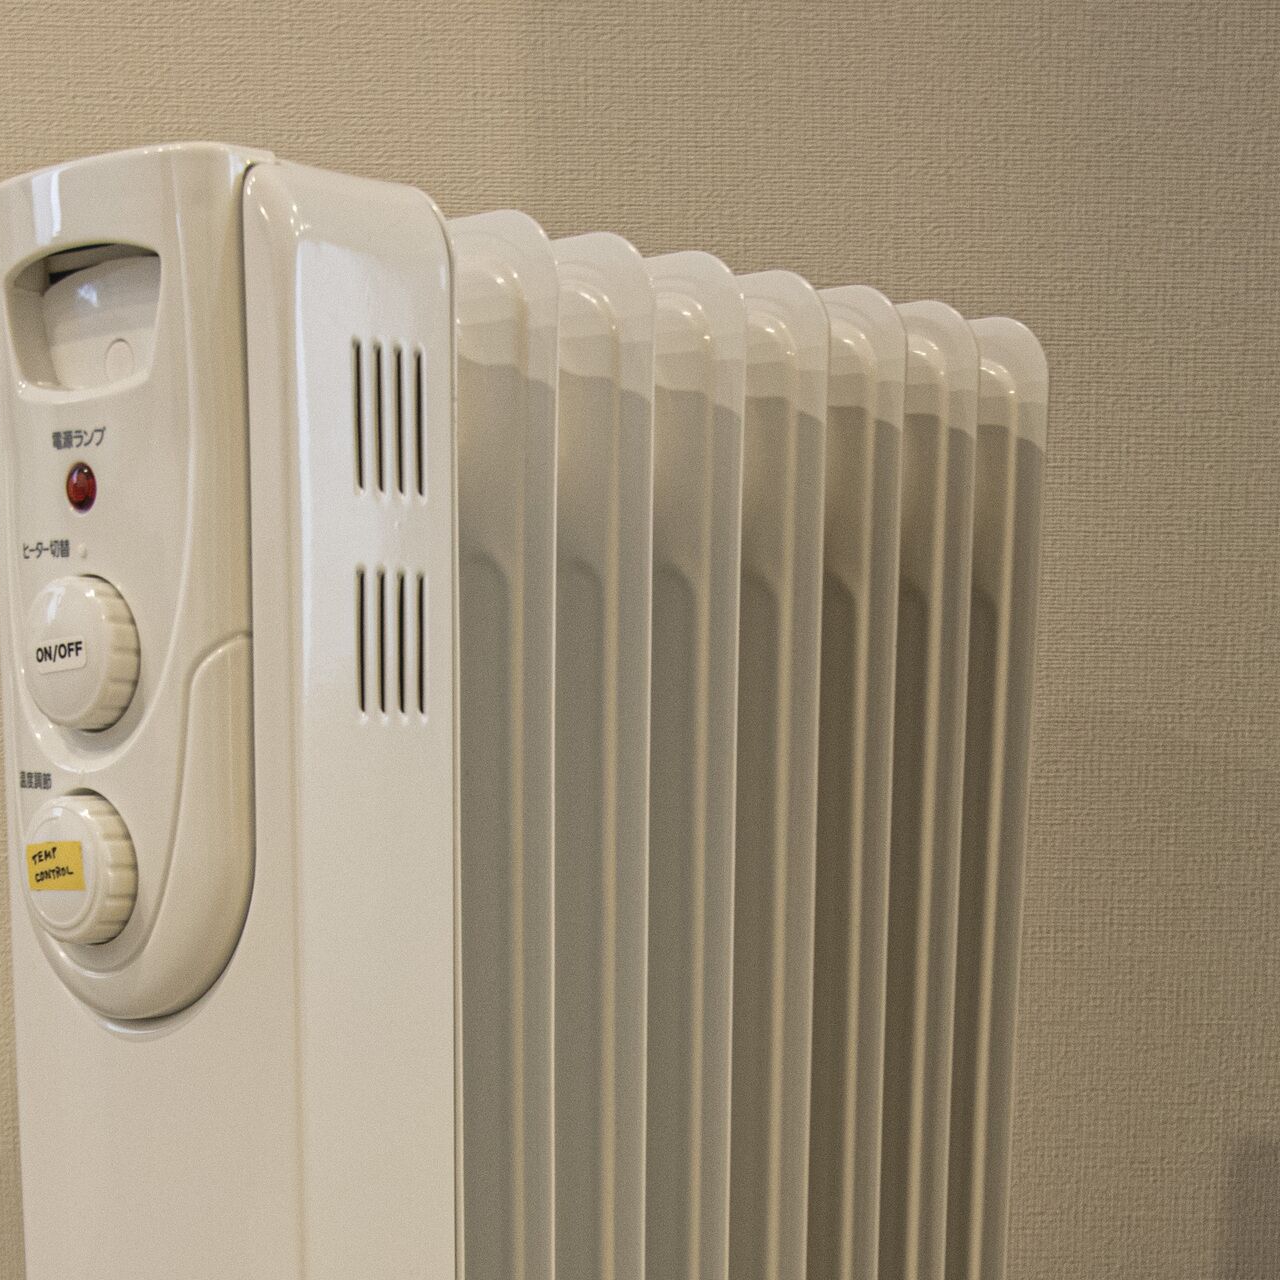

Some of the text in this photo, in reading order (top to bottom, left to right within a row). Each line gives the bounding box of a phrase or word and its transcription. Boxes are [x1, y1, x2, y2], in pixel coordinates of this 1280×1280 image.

[52, 426, 106, 450] 電源ランプ
[36, 641, 83, 663] ON/OFF
[31, 846, 58, 865] TEMP
[34, 865, 74, 883] CONTROL
